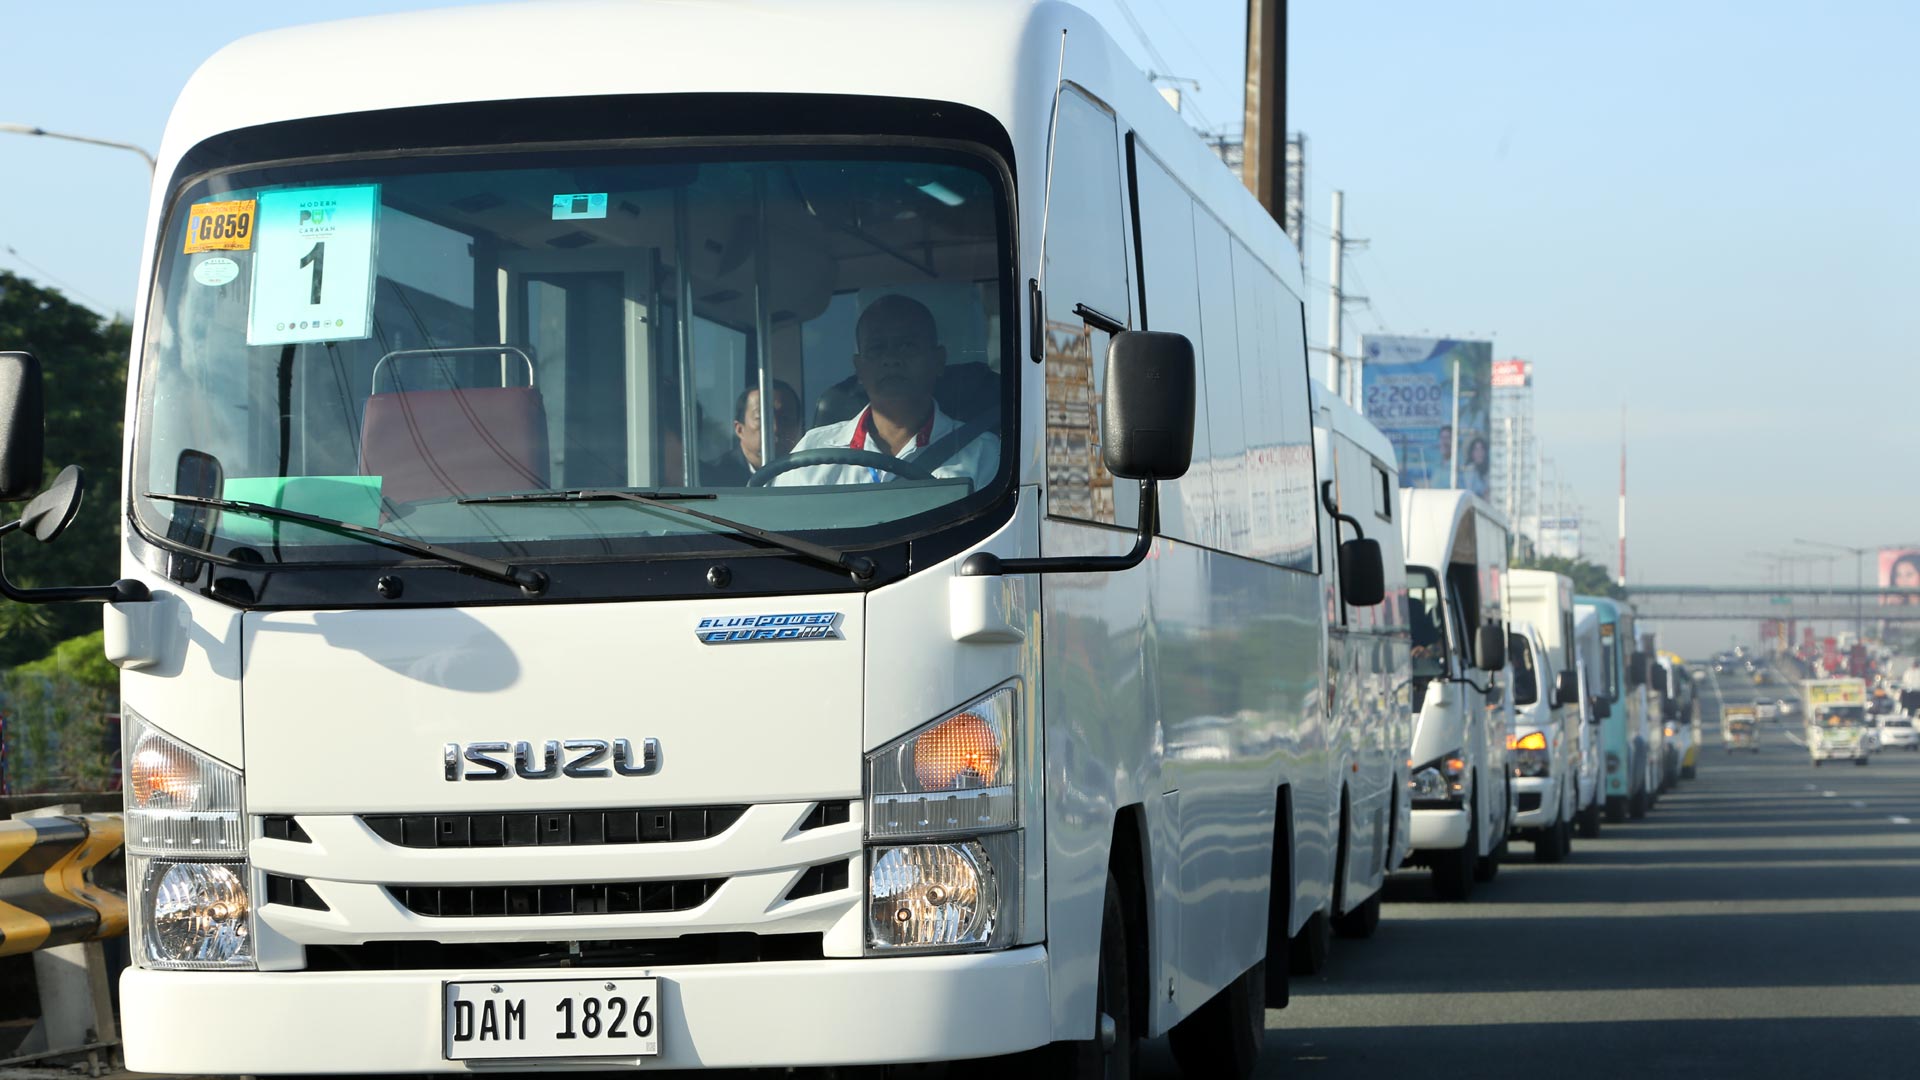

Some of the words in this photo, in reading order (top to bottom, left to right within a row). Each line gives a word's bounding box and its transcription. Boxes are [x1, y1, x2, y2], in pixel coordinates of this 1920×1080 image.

[300, 200, 337, 208] MODERN
[199, 212, 250, 241] G859
[299, 208, 337, 226] PUV
[299, 226, 336, 234] CARAVAN
[299, 241, 325, 305] 1
[705, 628, 800, 641] EURO
[444, 737, 659, 781] ISUZU
[453, 999, 525, 1041] DAM
[556, 996, 652, 1040] 1826
